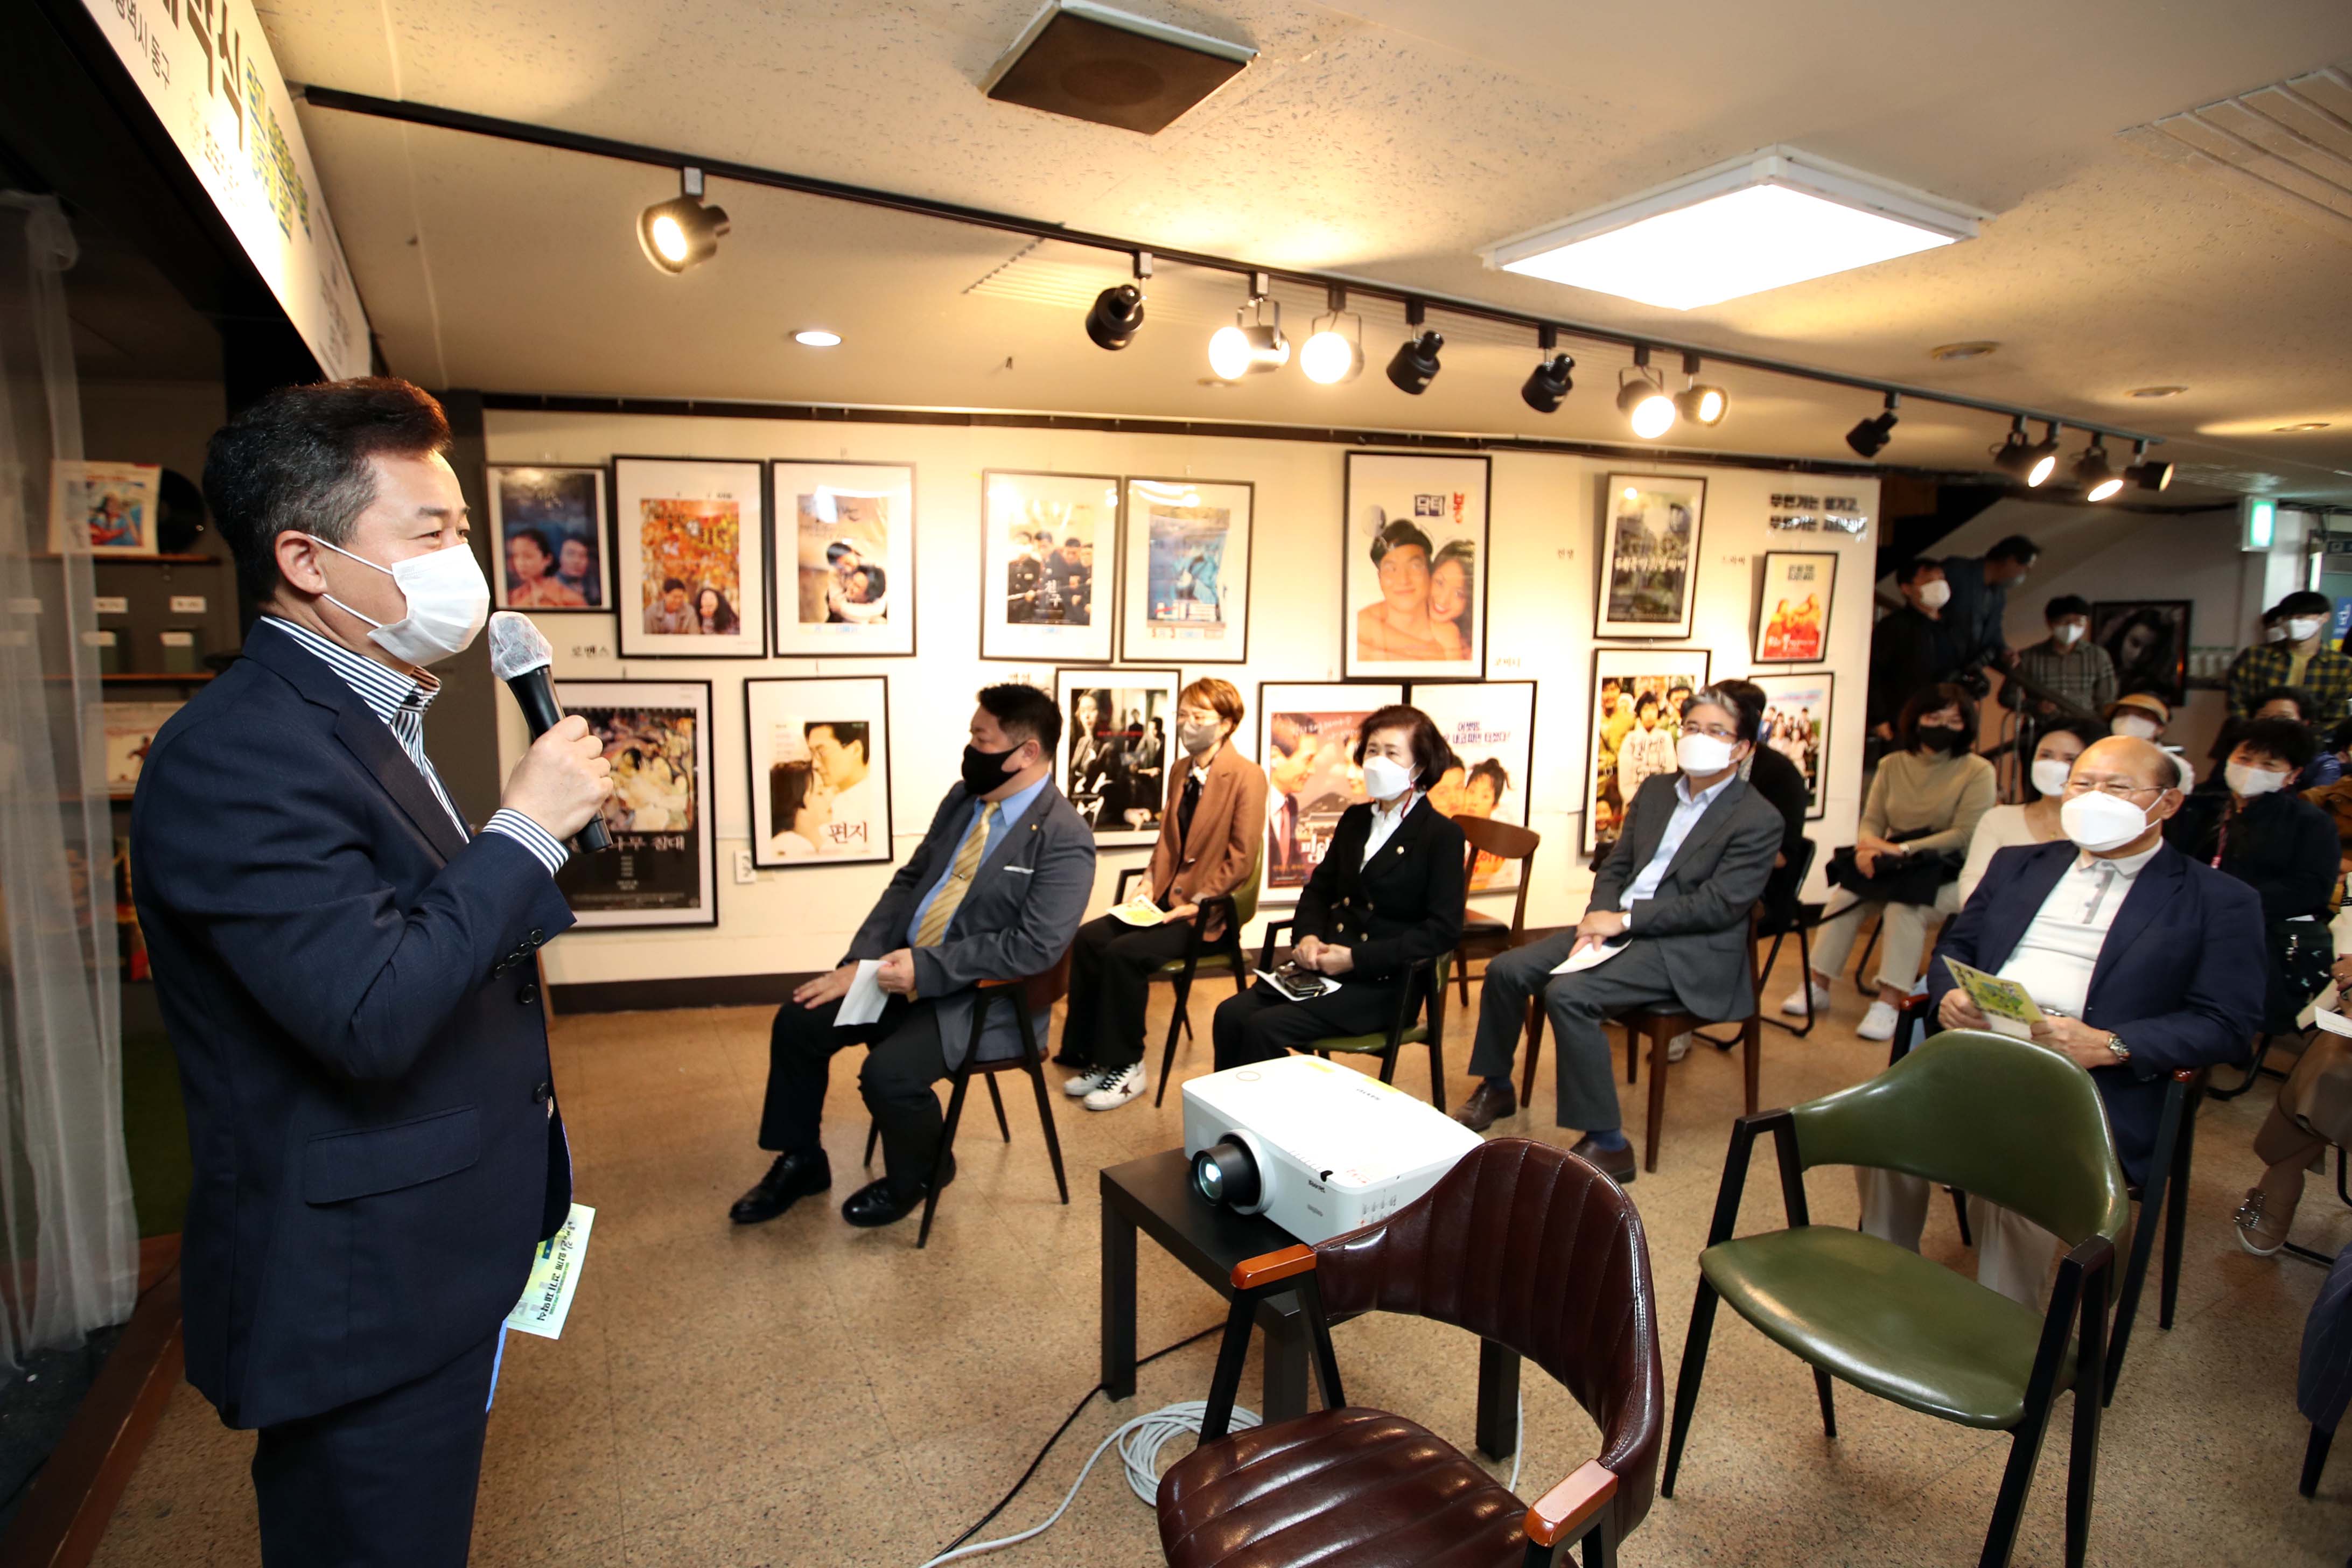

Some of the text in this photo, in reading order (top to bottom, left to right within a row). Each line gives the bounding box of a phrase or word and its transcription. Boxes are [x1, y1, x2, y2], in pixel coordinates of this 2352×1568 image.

[151, 33, 170, 90] 동구
[1414, 494, 1445, 516] 닥터
[1044, 579, 1063, 608] 친구
[1155, 601, 1217, 620] 비트
[571, 644, 610, 658] 로맨스
[653, 834, 684, 851] 침대
[829, 821, 867, 844] 편지
